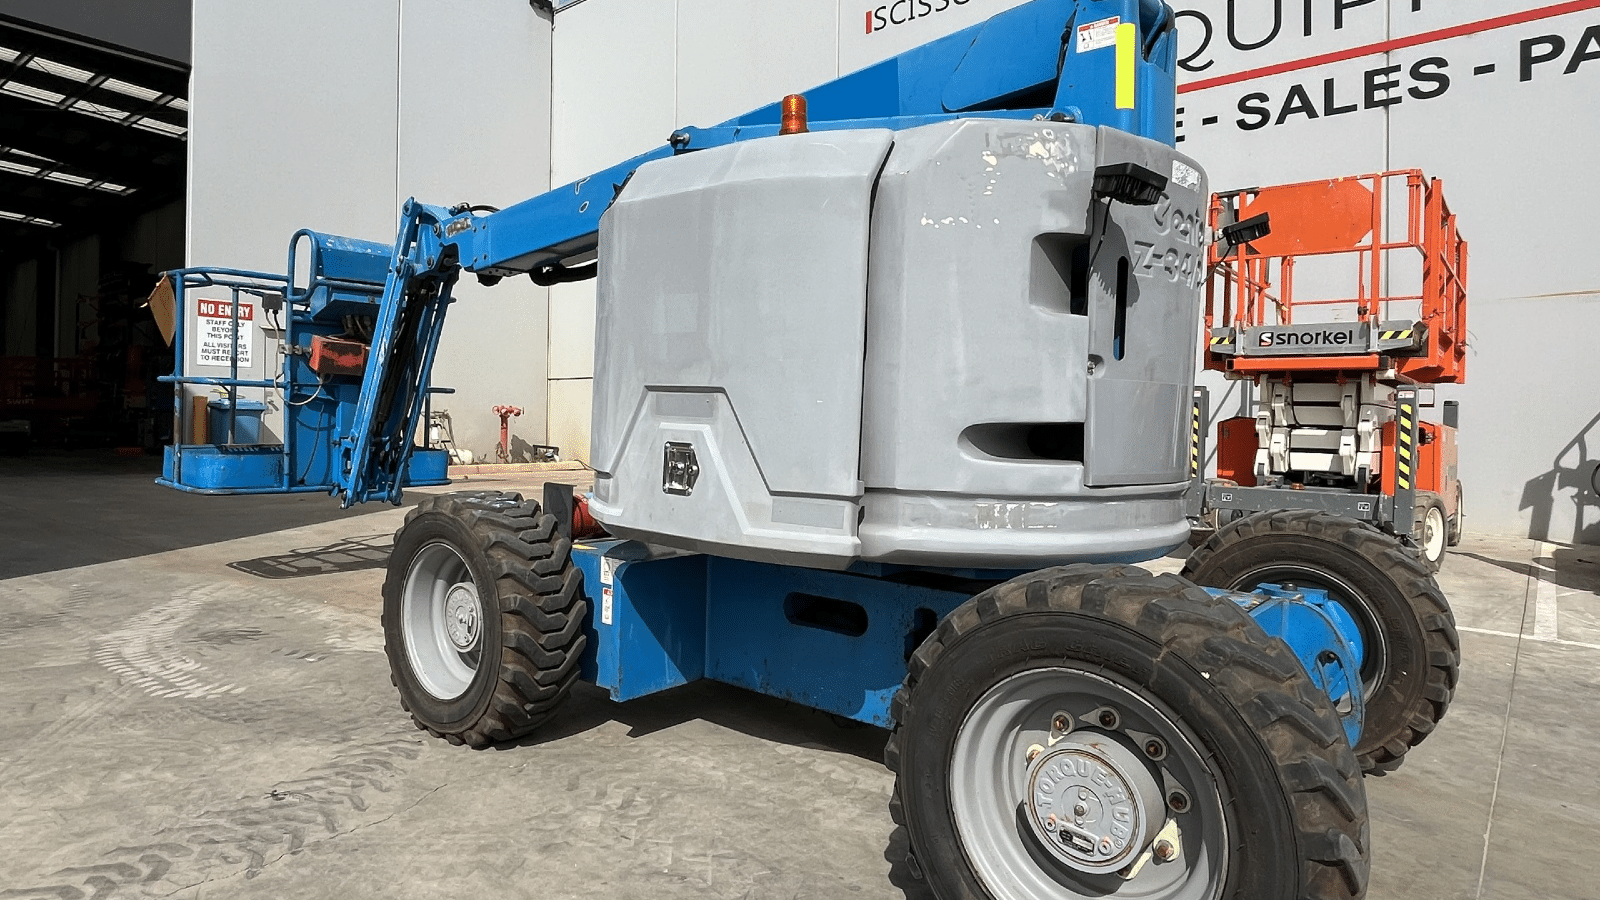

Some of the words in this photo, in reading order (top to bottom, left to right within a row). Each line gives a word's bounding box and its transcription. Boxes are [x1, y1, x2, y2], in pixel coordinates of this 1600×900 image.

[1236, 56, 1451, 131] SALES
[200, 303, 215, 315] NO
[218, 304, 250, 317] ENRY
[228, 320, 246, 328] OLY
[1275, 329, 1353, 346] snorkel
